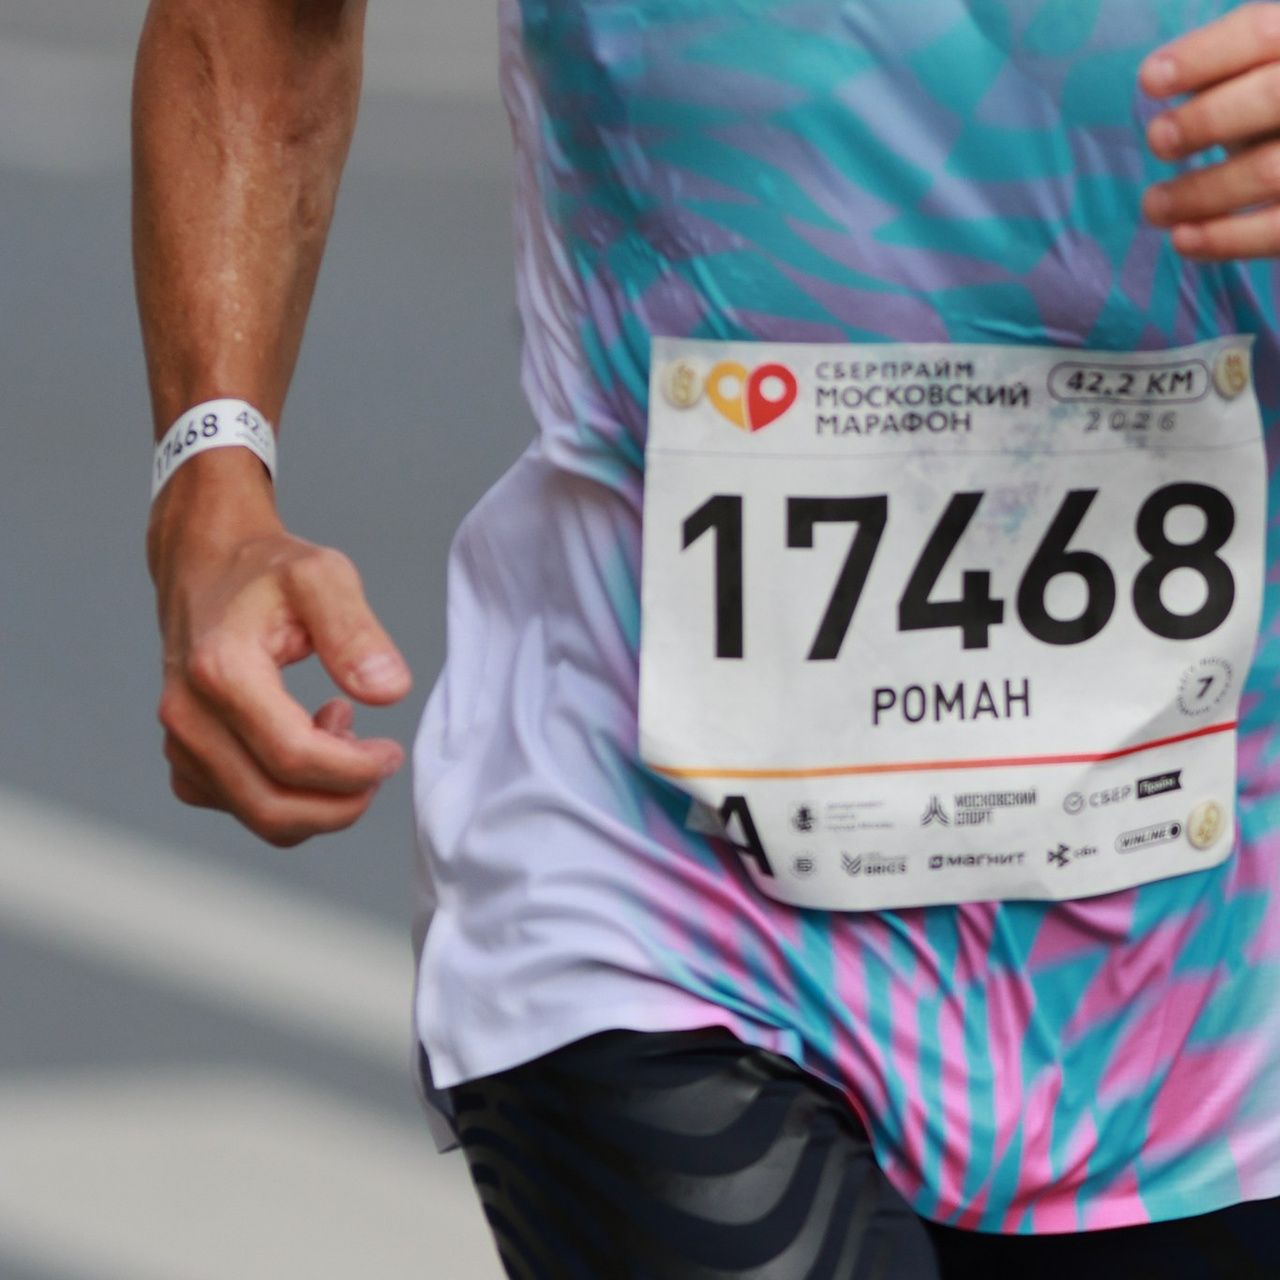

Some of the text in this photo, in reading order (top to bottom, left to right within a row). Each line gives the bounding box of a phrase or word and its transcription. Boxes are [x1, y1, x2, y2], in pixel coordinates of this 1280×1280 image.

[815, 361, 975, 381] СБЕРПРАЙМ
[815, 382, 1031, 409] МОСКОВСКИЙ
[815, 411, 972, 436] МАРАФОН
[1084, 410, 1176, 433] 2026
[681, 481, 1236, 661] 17468
[872, 679, 1031, 726] РОМАН
[955, 789, 1037, 807] МОСКОВСКИЙ
